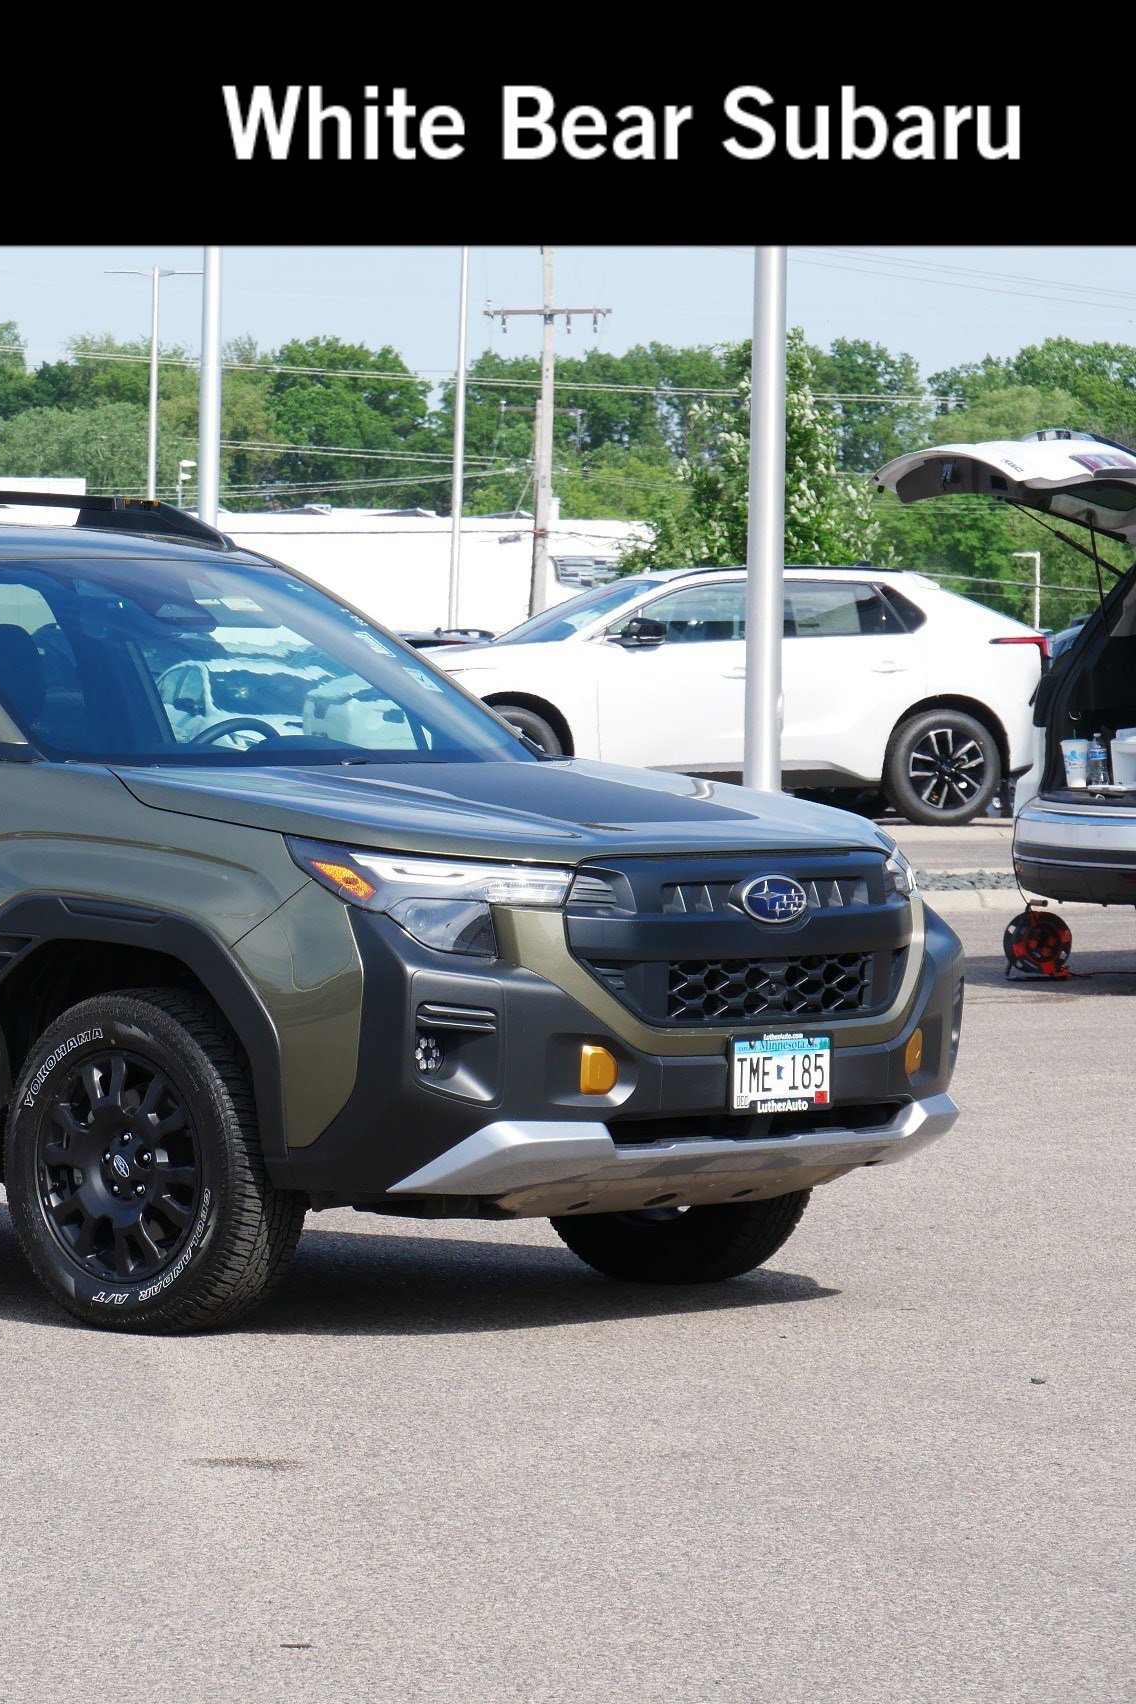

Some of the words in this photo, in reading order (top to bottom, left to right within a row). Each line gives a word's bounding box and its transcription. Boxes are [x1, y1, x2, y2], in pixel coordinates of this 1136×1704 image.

[759, 1040, 805, 1051] Minnesota
[23, 1028, 104, 1108] YOKOHAMA
[737, 1056, 773, 1093] TME
[788, 1053, 824, 1091] 185
[757, 1099, 808, 1113] LutherAuto
[91, 1291, 130, 1305] A/T
